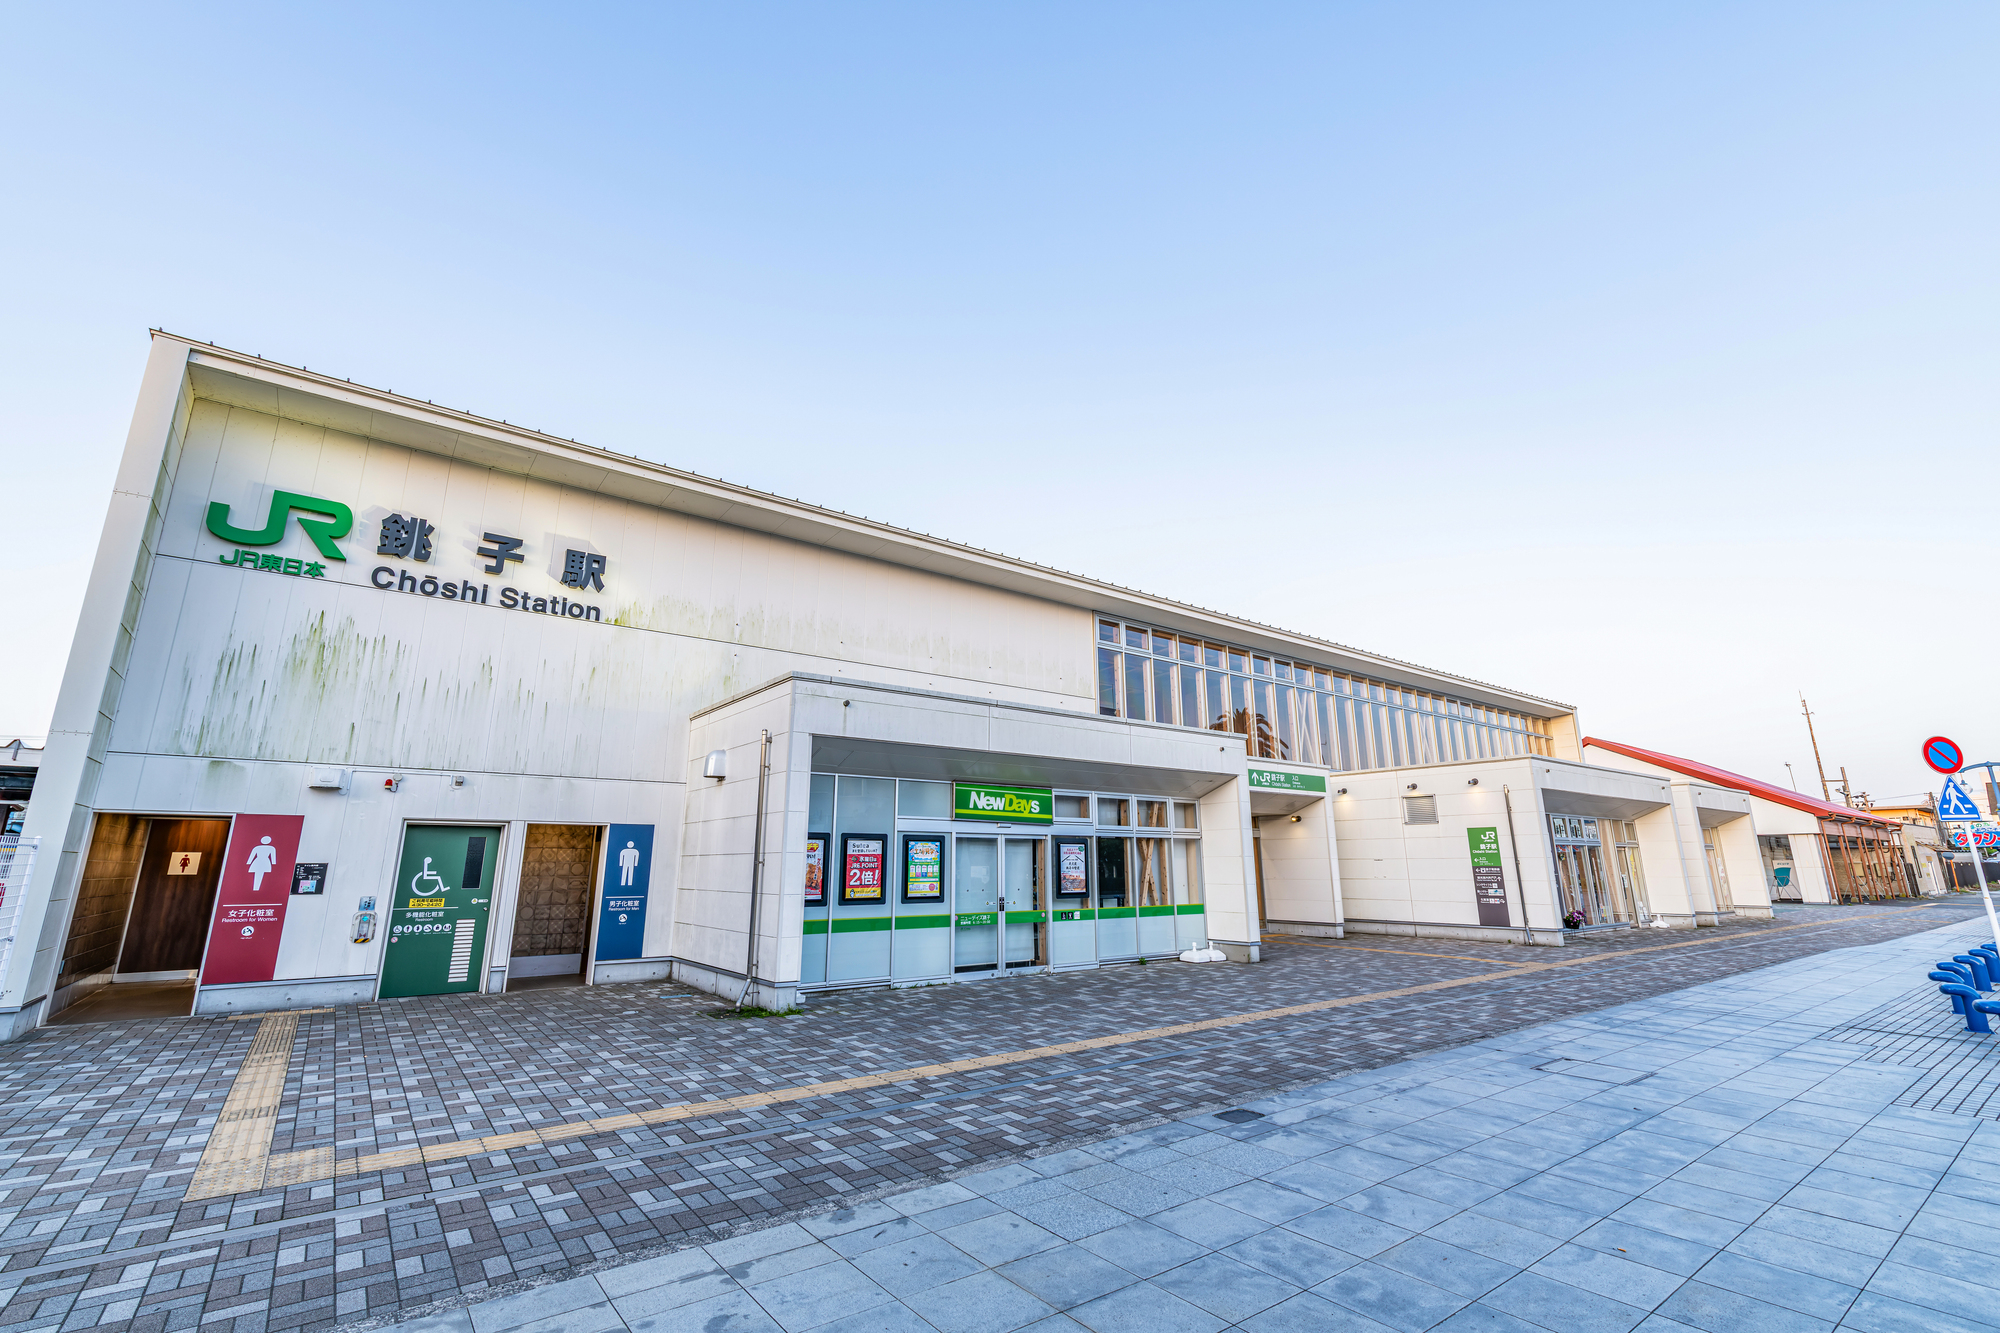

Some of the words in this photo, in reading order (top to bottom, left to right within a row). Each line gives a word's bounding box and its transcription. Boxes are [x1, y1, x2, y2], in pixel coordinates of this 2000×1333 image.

[206, 489, 353, 562] JR
[219, 548, 326, 577] JR東日本
[377, 513, 606, 593] 銚子駅
[371, 566, 488, 604] Chōshi
[500, 587, 601, 621] Station
[1260, 772, 1270, 782] JR
[1271, 773, 1285, 781] 銚子駅
[969, 791, 1040, 814] NewDays
[1481, 831, 1495, 839] JR
[849, 869, 879, 886] 2倍!
[228, 909, 274, 917] 女子化粧室
